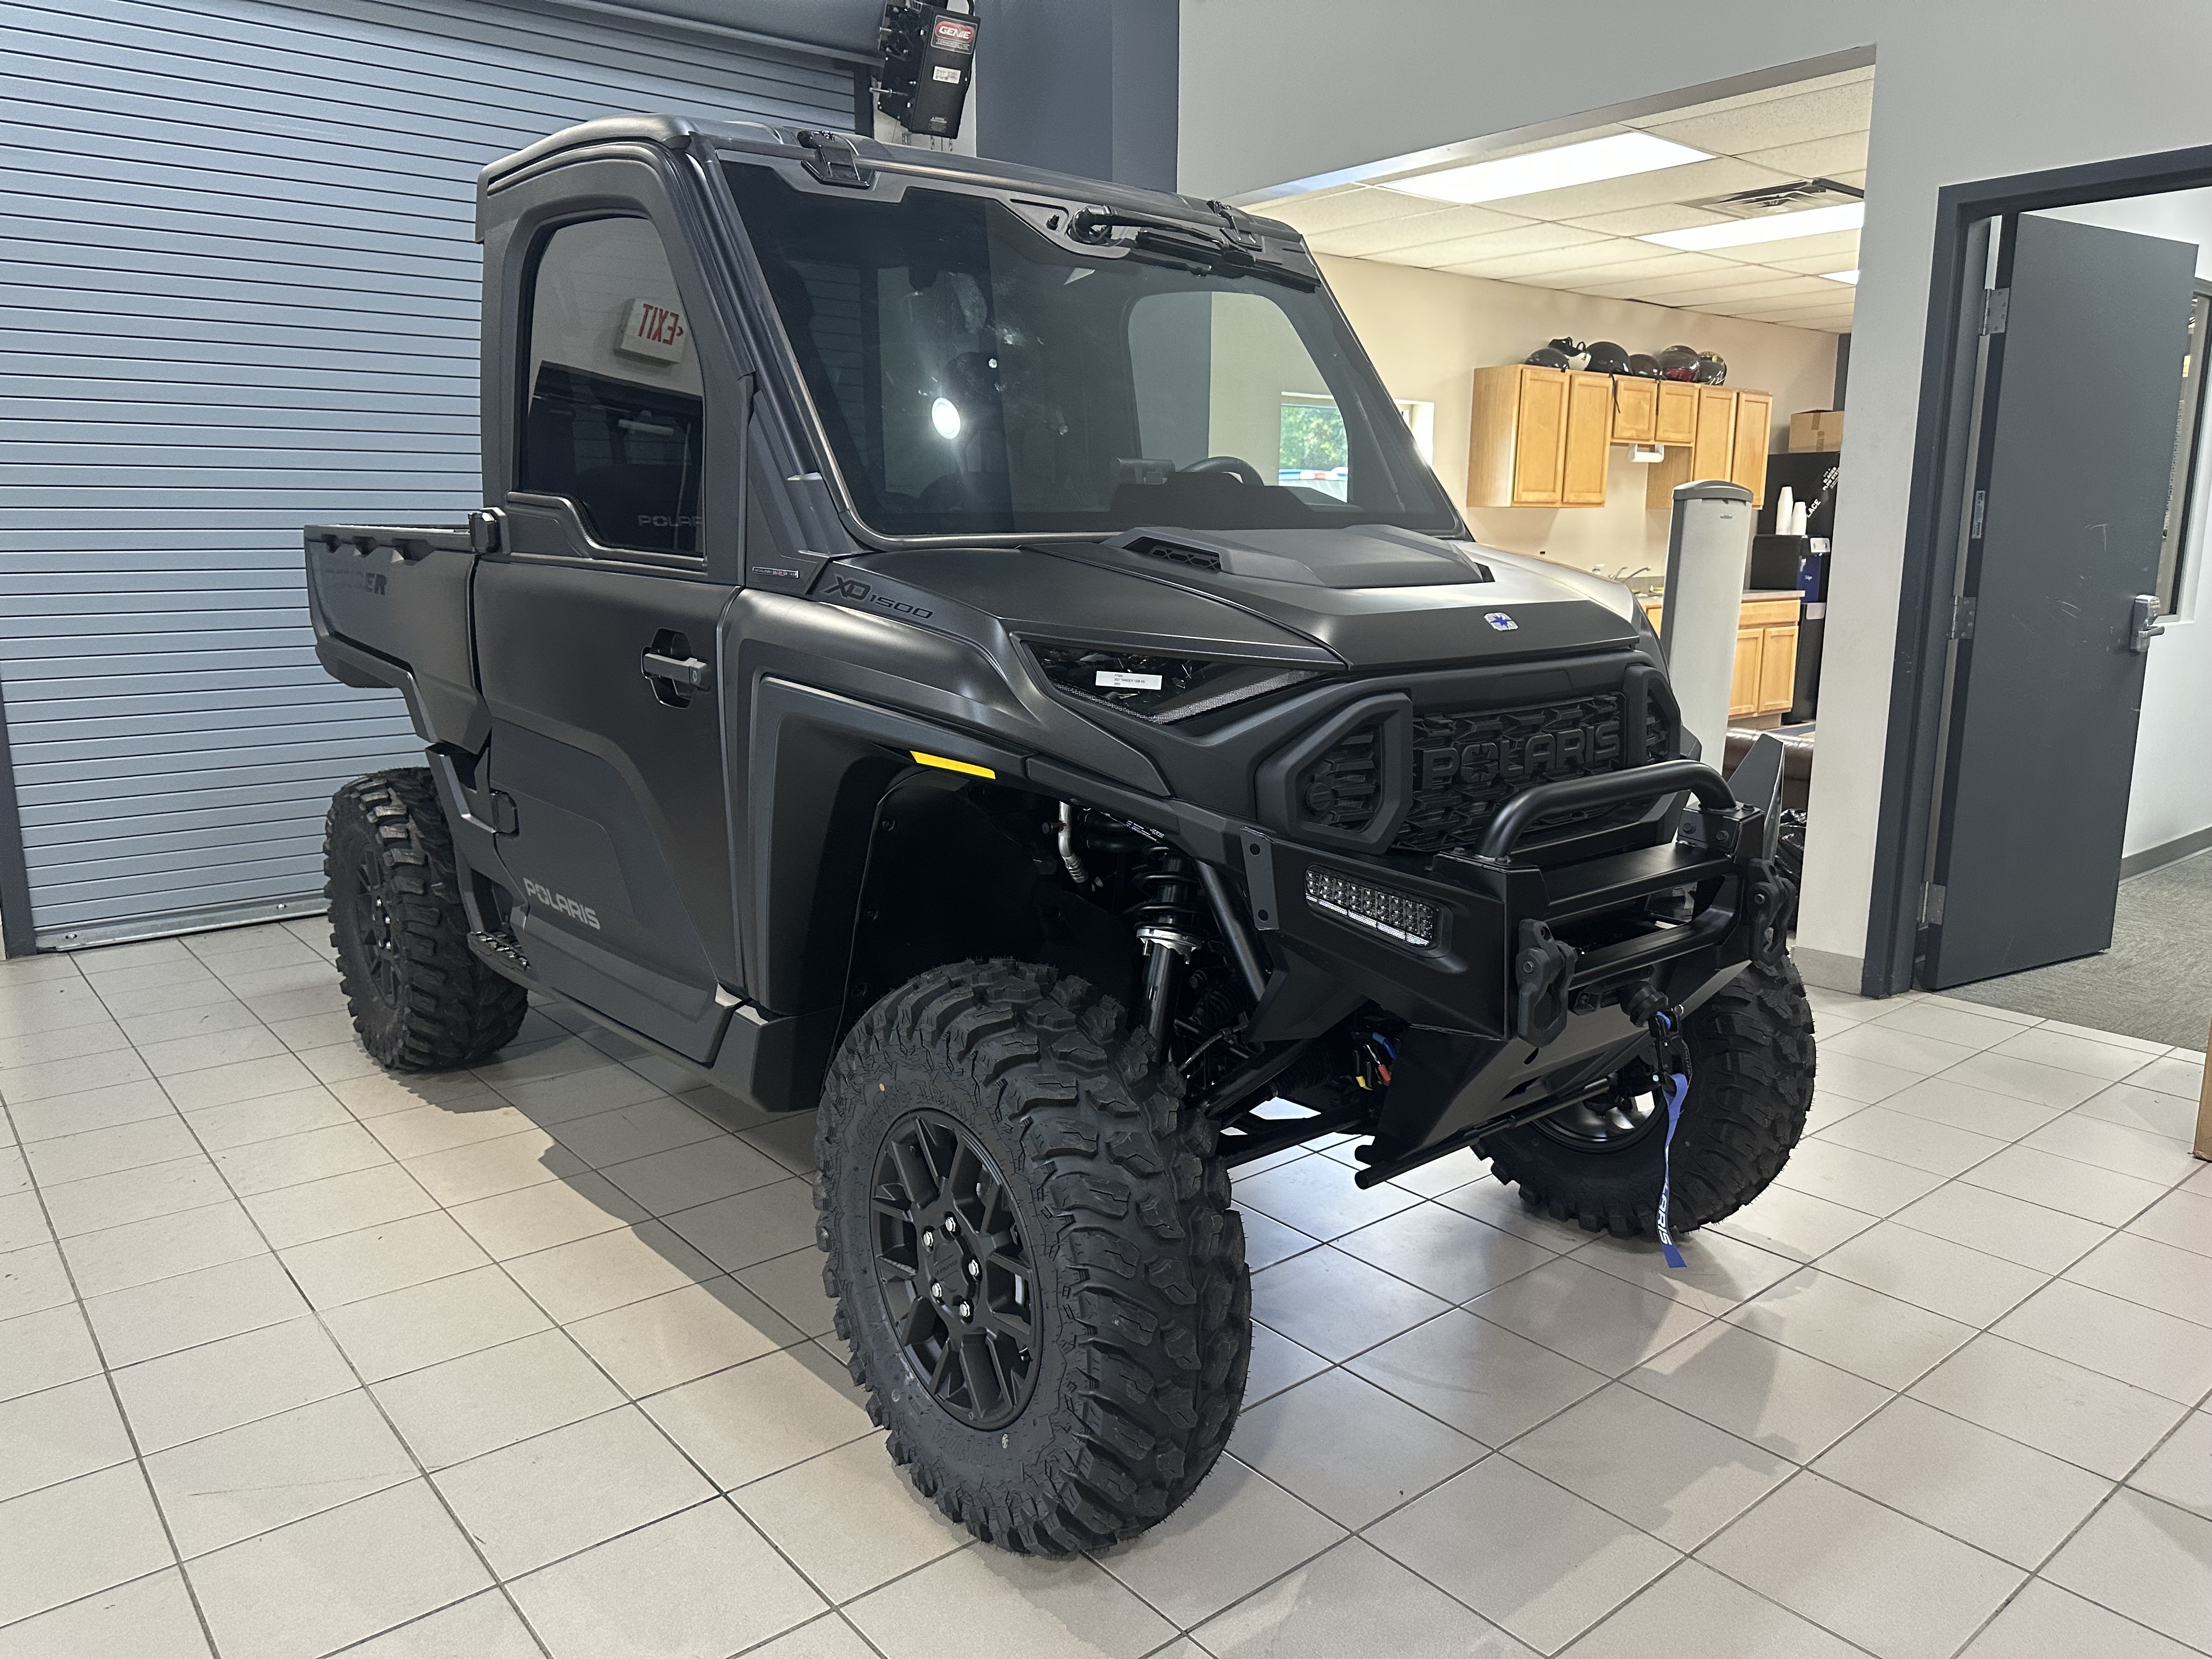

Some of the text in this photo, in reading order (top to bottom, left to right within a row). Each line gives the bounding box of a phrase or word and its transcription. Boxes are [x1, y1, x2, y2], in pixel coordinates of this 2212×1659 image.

[939, 26, 971, 40] GENIE
[869, 594, 934, 619] 1500
[1421, 720, 1620, 790] POLARIS
[523, 877, 601, 930] POLARIS
[1657, 1178, 1673, 1245] LARIS
